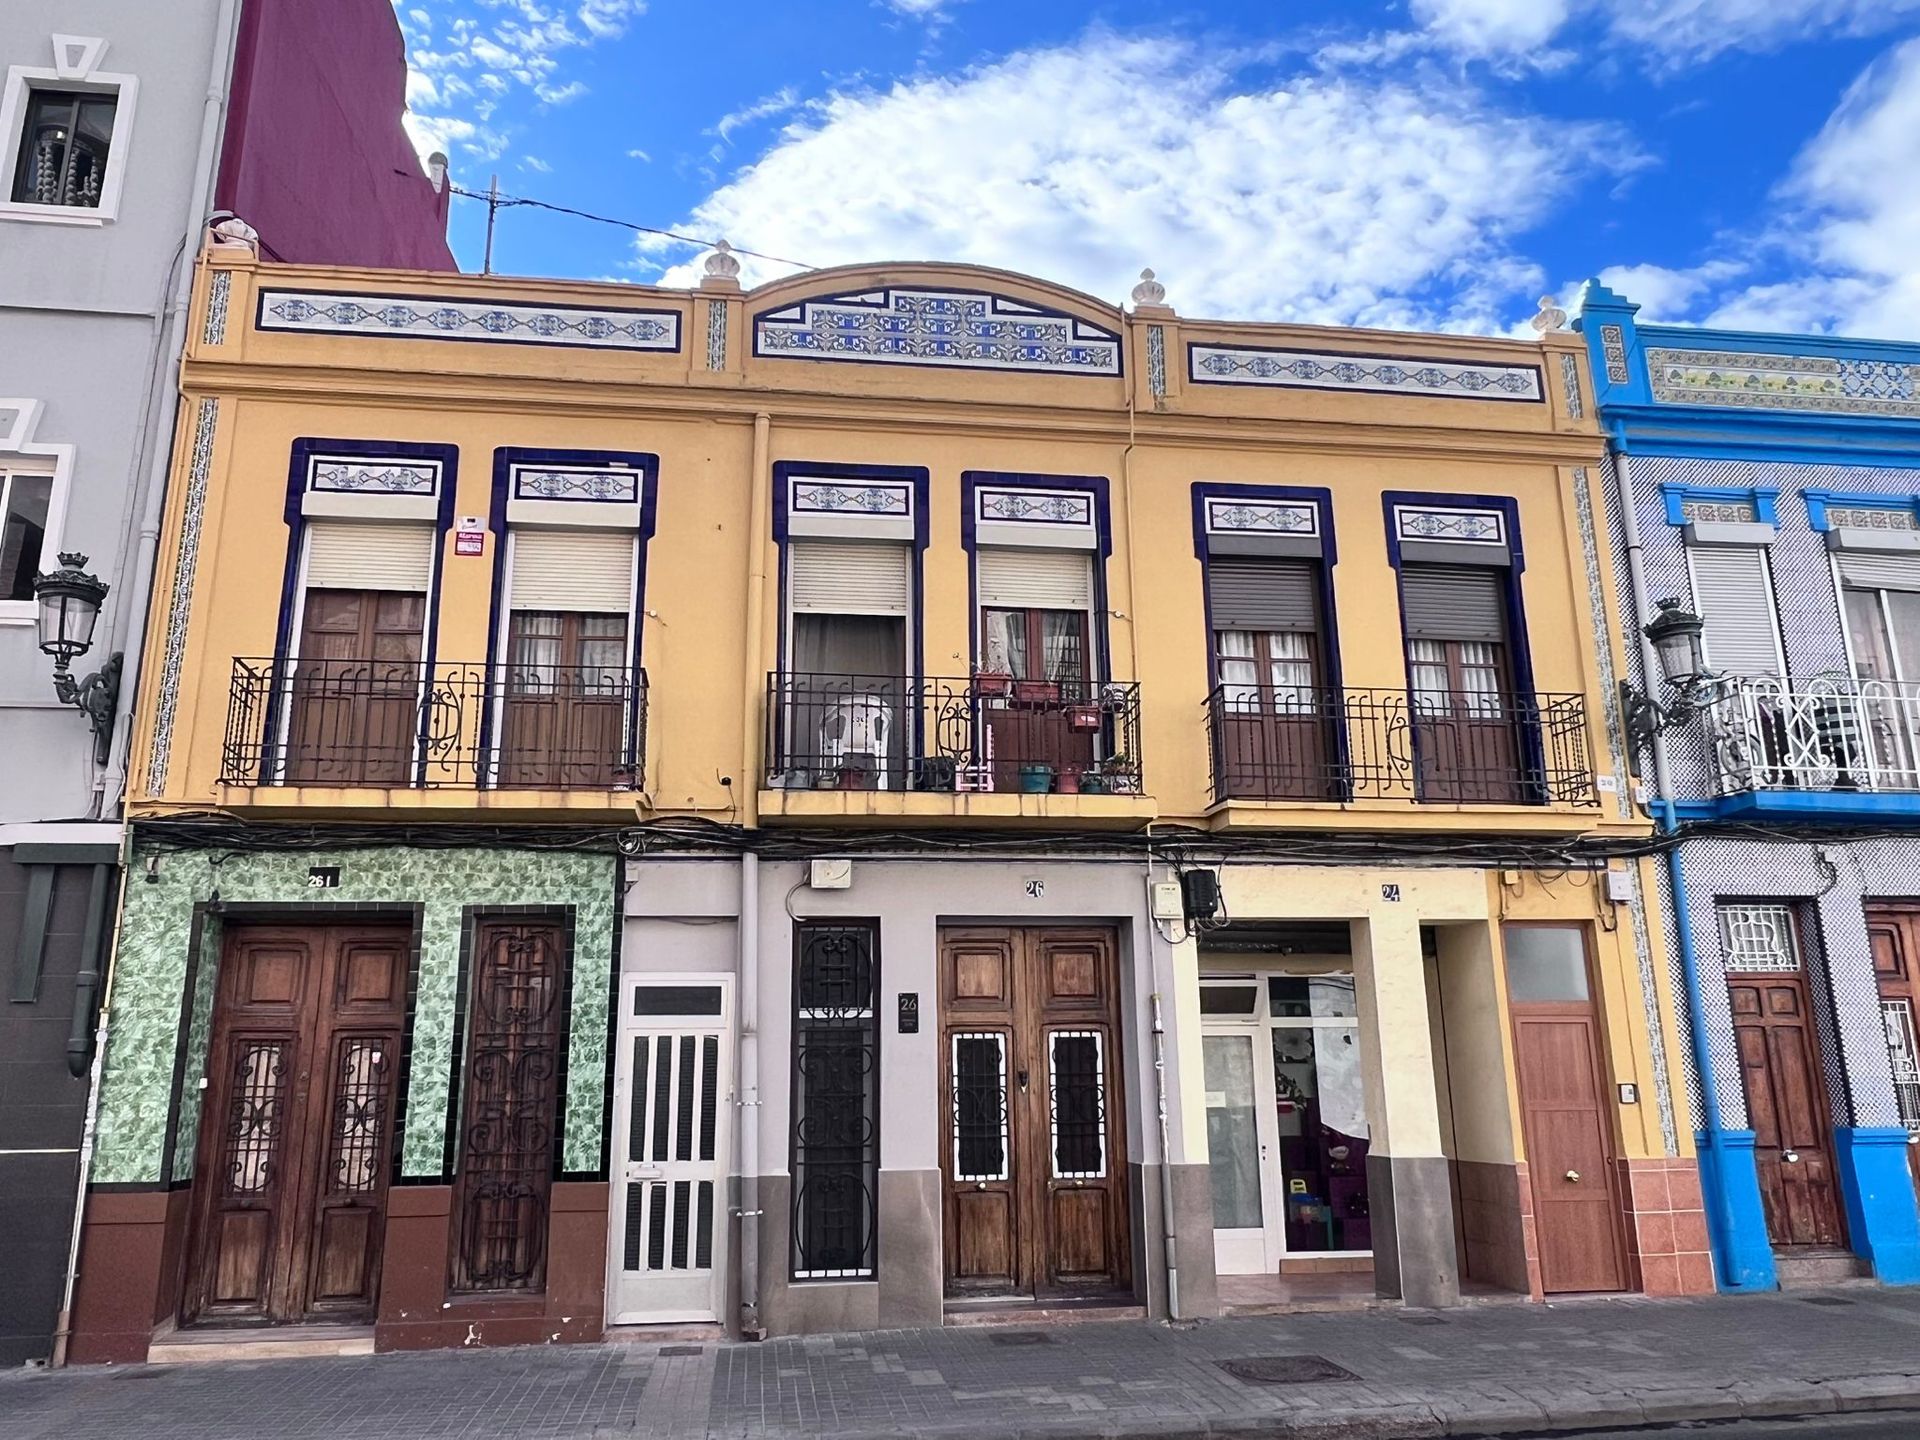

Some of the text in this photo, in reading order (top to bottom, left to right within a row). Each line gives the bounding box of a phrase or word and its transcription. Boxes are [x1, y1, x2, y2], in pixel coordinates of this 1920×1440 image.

[1026, 881, 1044, 897] 26
[1383, 885, 1399, 902] 24
[901, 998, 917, 1011] 26
